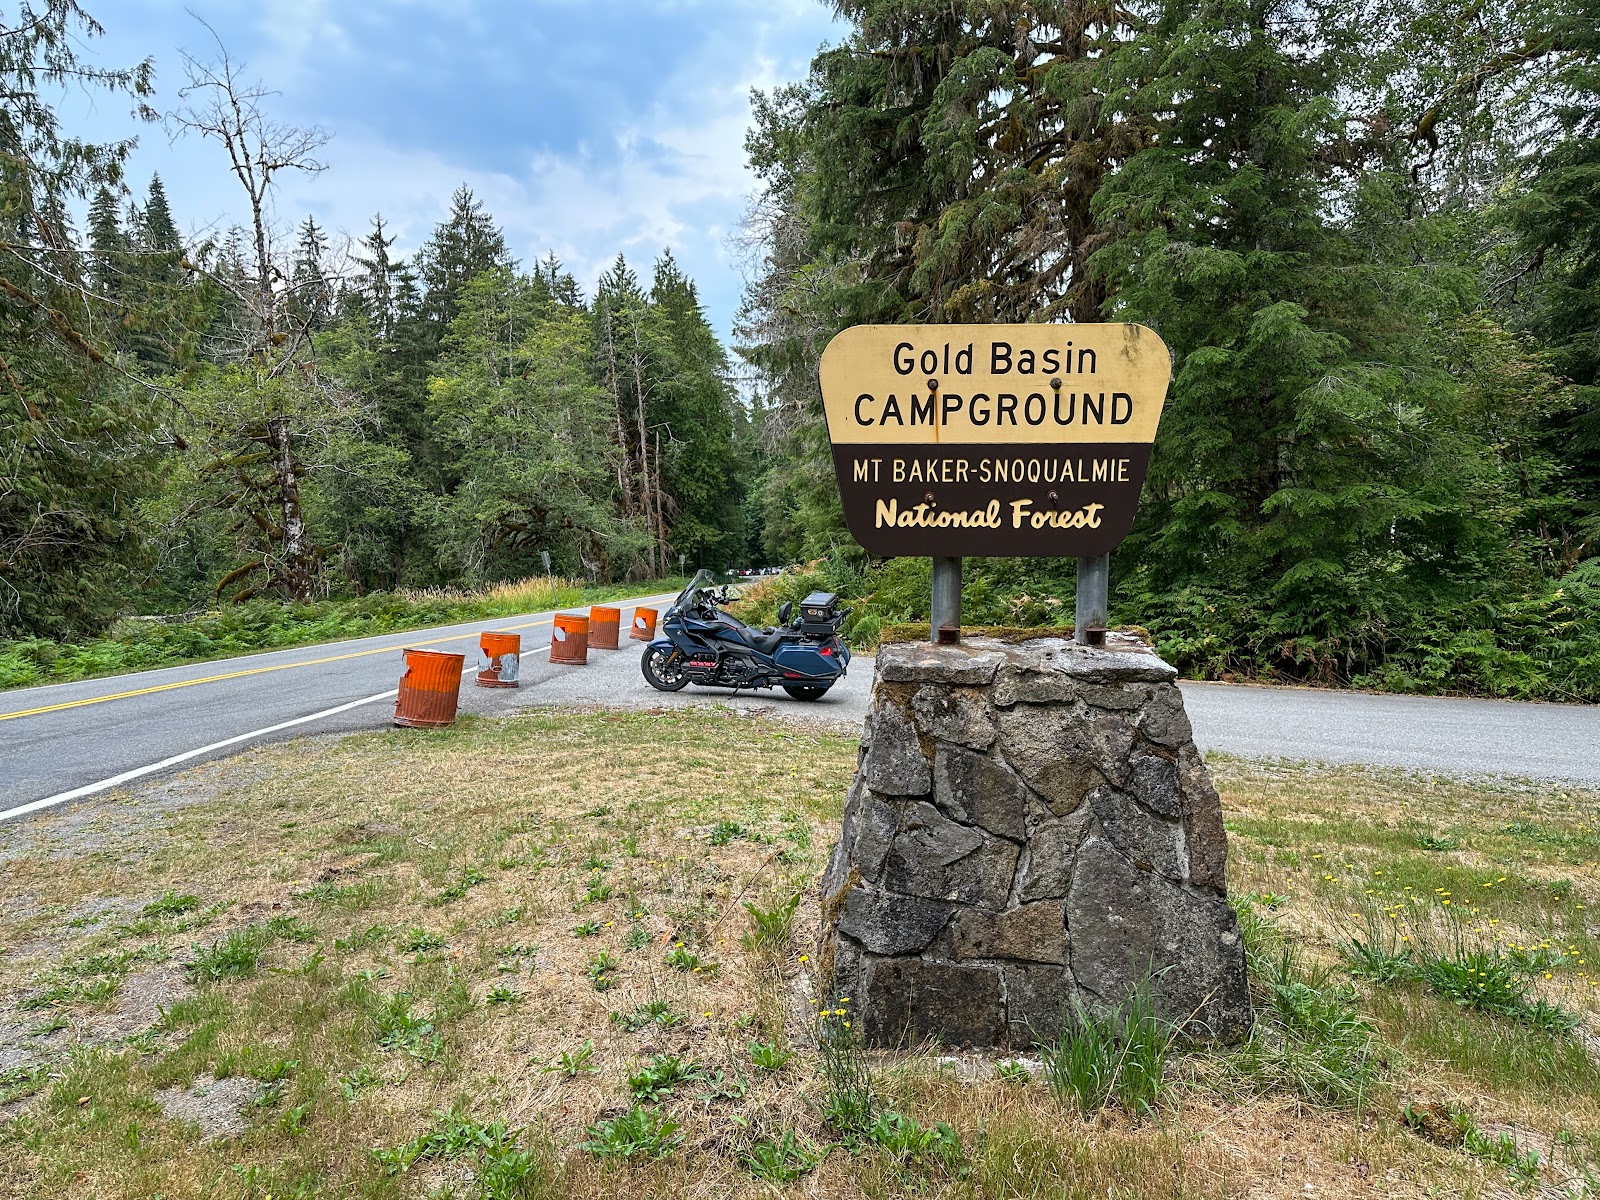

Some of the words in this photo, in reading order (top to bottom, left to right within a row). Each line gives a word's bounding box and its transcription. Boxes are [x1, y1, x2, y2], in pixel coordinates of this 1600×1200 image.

[893, 342, 973, 375] Gold
[990, 341, 1097, 375] Basin
[854, 393, 1133, 426] CAMPGROUND
[853, 459, 882, 482] MT
[893, 458, 1130, 483] BAKER-SNOQUALMIE
[875, 498, 1001, 529] National
[1008, 499, 1104, 529] Forest
